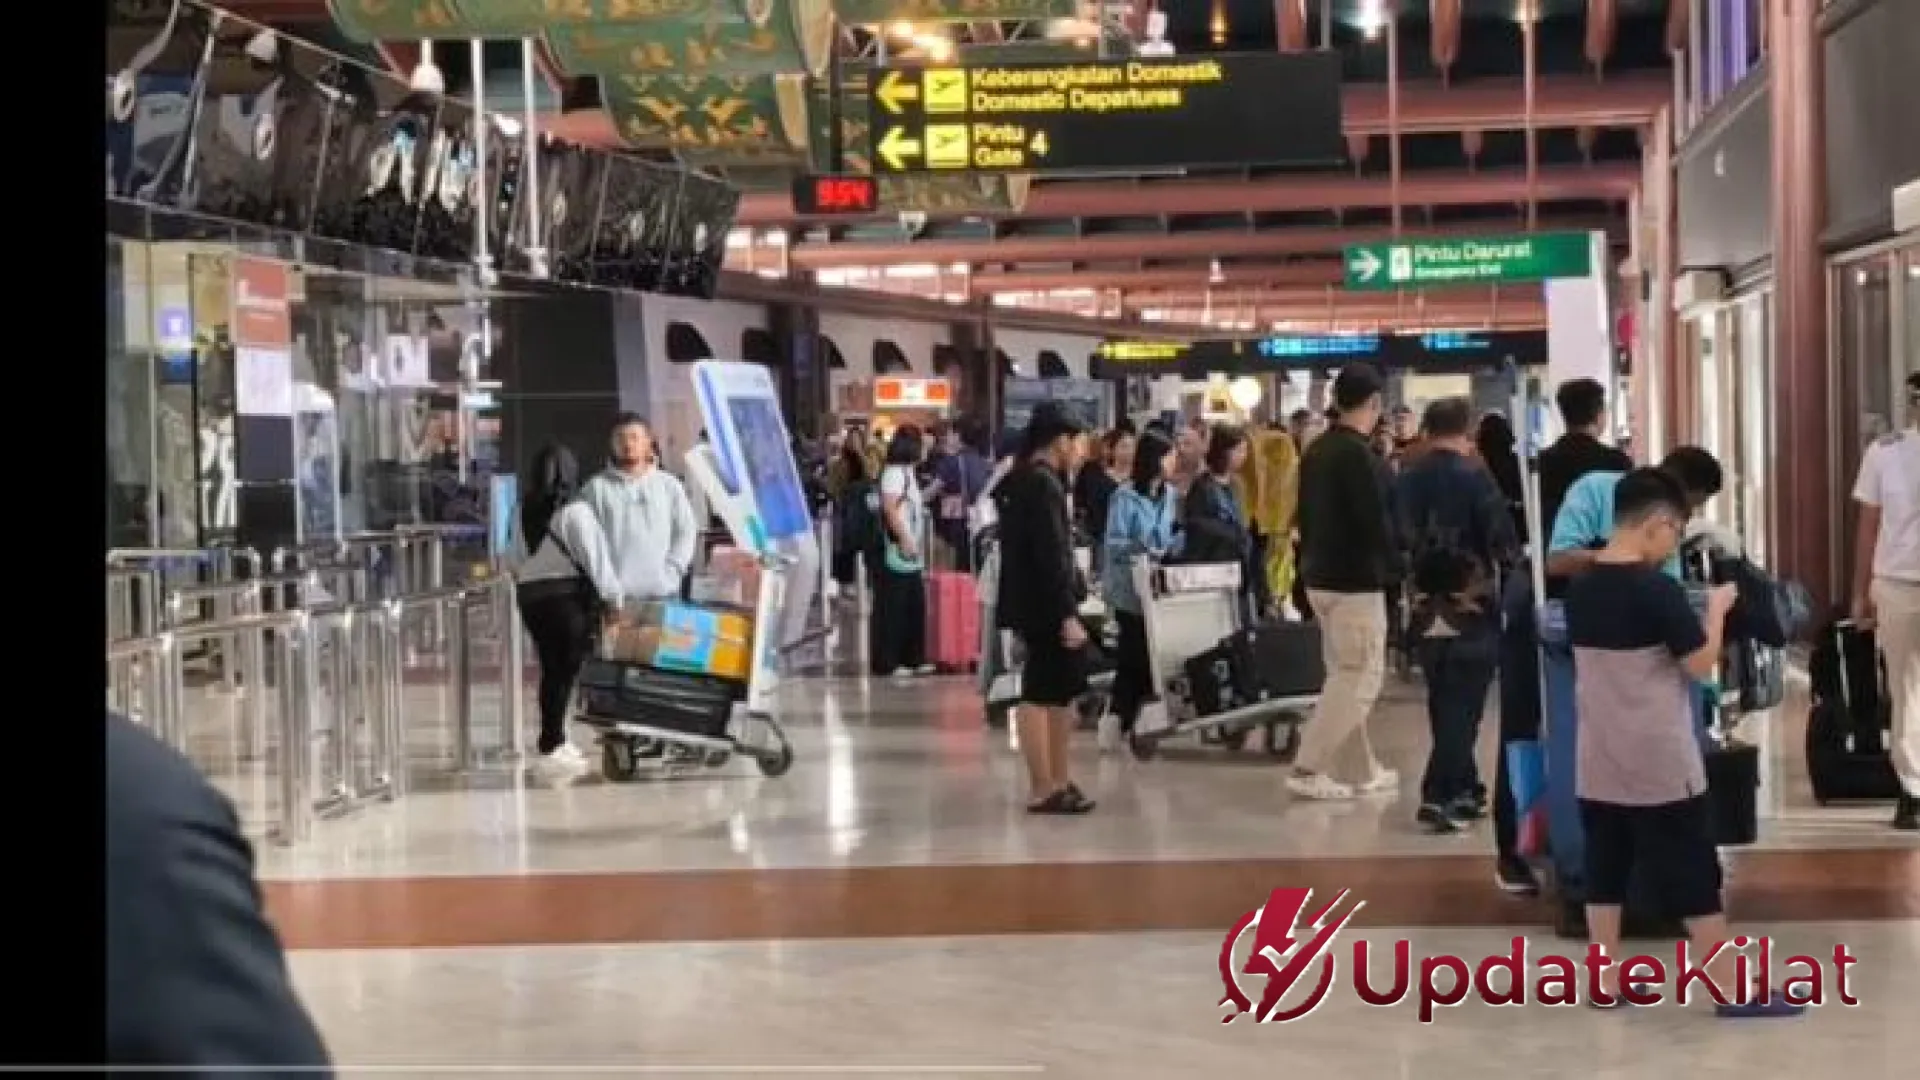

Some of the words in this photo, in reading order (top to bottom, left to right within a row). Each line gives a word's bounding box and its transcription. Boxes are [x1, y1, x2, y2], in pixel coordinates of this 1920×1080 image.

[973, 66, 1122, 91] Keberangkatan
[1127, 61, 1222, 83] Domestik
[973, 90, 1065, 112] Domestic
[1070, 88, 1182, 113] Departures
[973, 122, 1025, 143] Pintu
[1030, 129, 1050, 157] 4
[975, 147, 1025, 166] Gate
